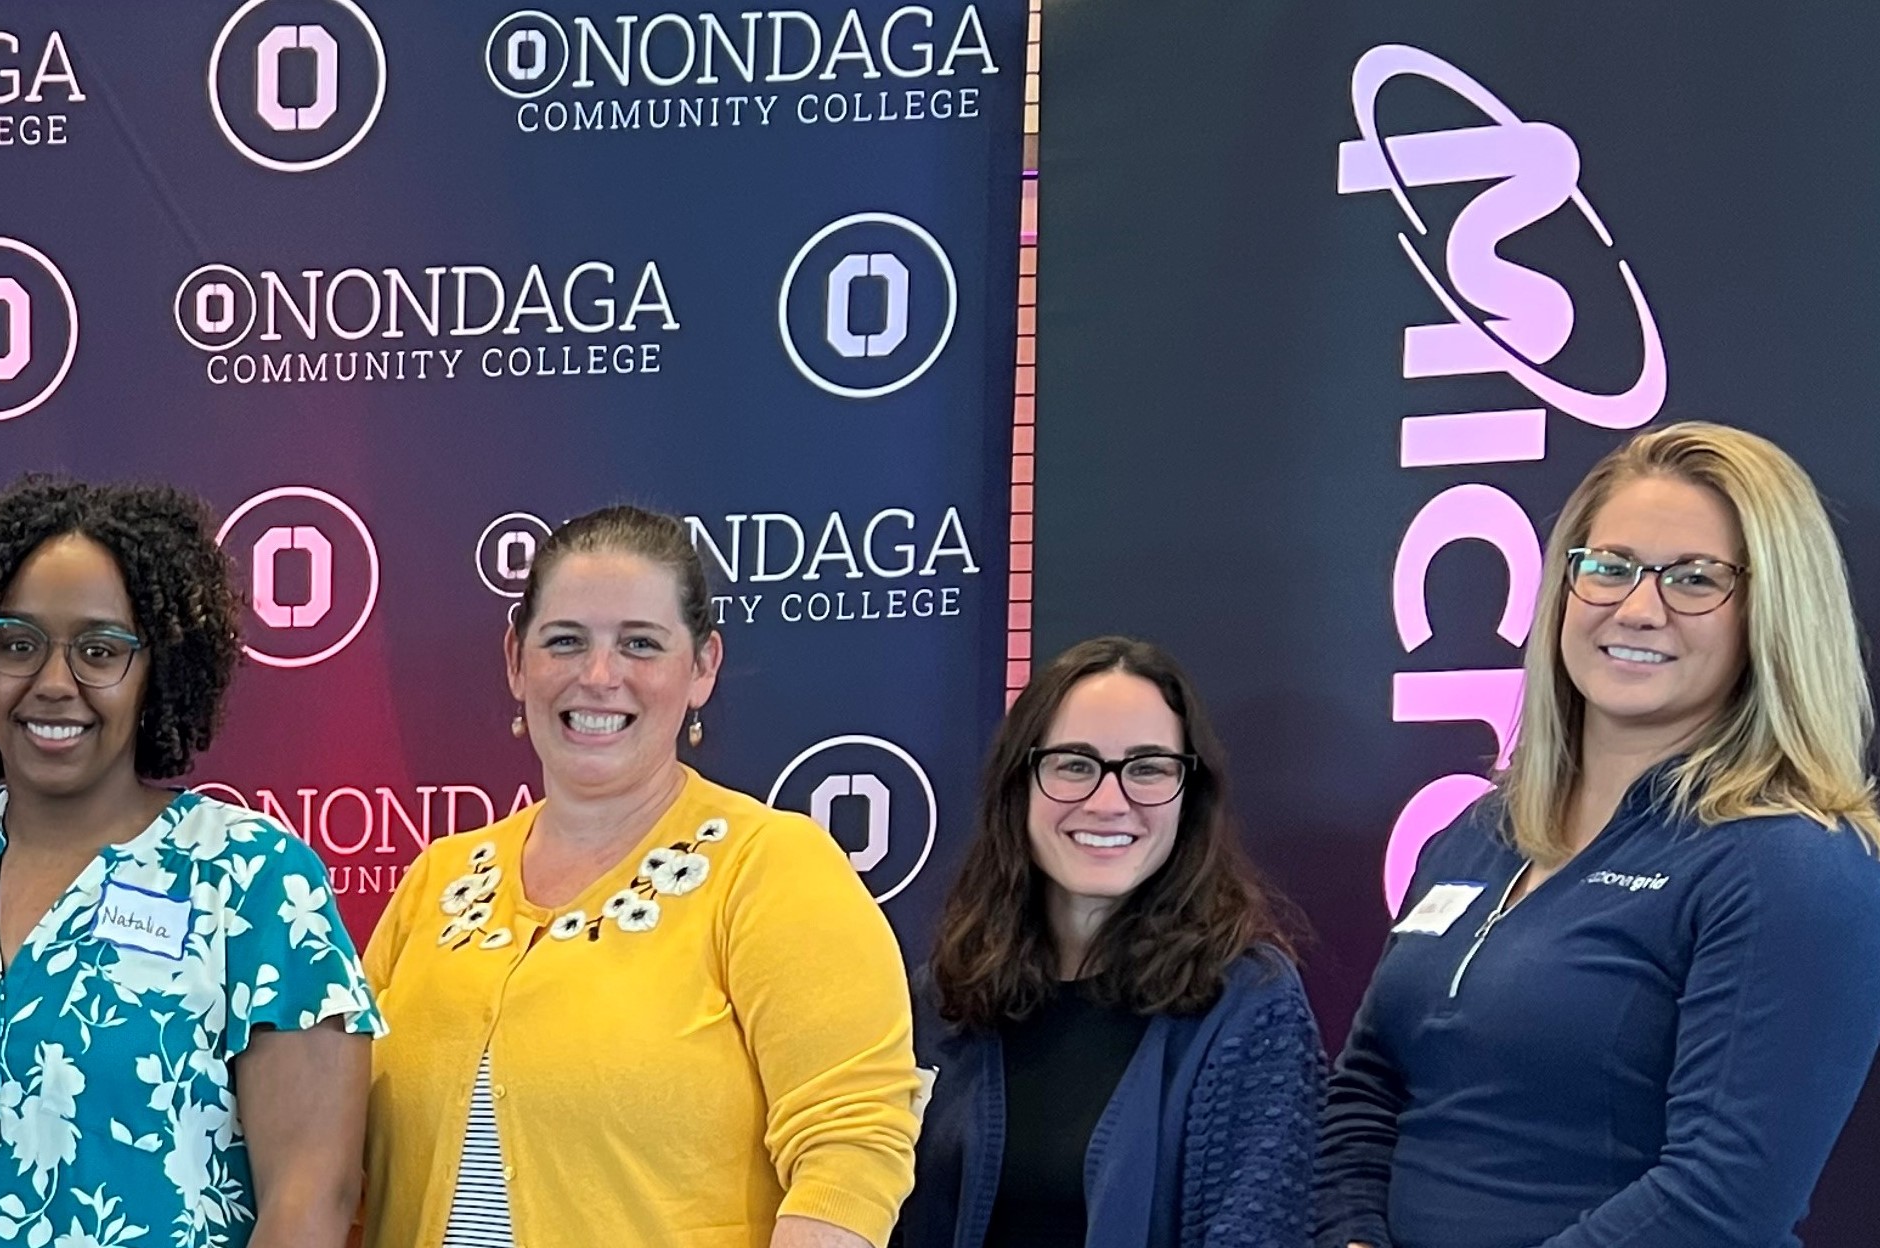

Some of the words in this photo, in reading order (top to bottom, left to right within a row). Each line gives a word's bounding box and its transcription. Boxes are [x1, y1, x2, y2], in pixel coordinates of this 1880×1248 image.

[485, 4, 999, 99] ONONDAGA
[516, 95, 778, 132] COMMUNITY
[797, 88, 979, 124] COLLEGE
[174, 261, 680, 352] ONONDAGA
[206, 349, 463, 385] COMMUNITY
[481, 343, 660, 378] COLLEGE
[476, 507, 980, 598] ONDAGA
[780, 587, 960, 622] COLLEGE
[101, 905, 171, 939] Natalia
